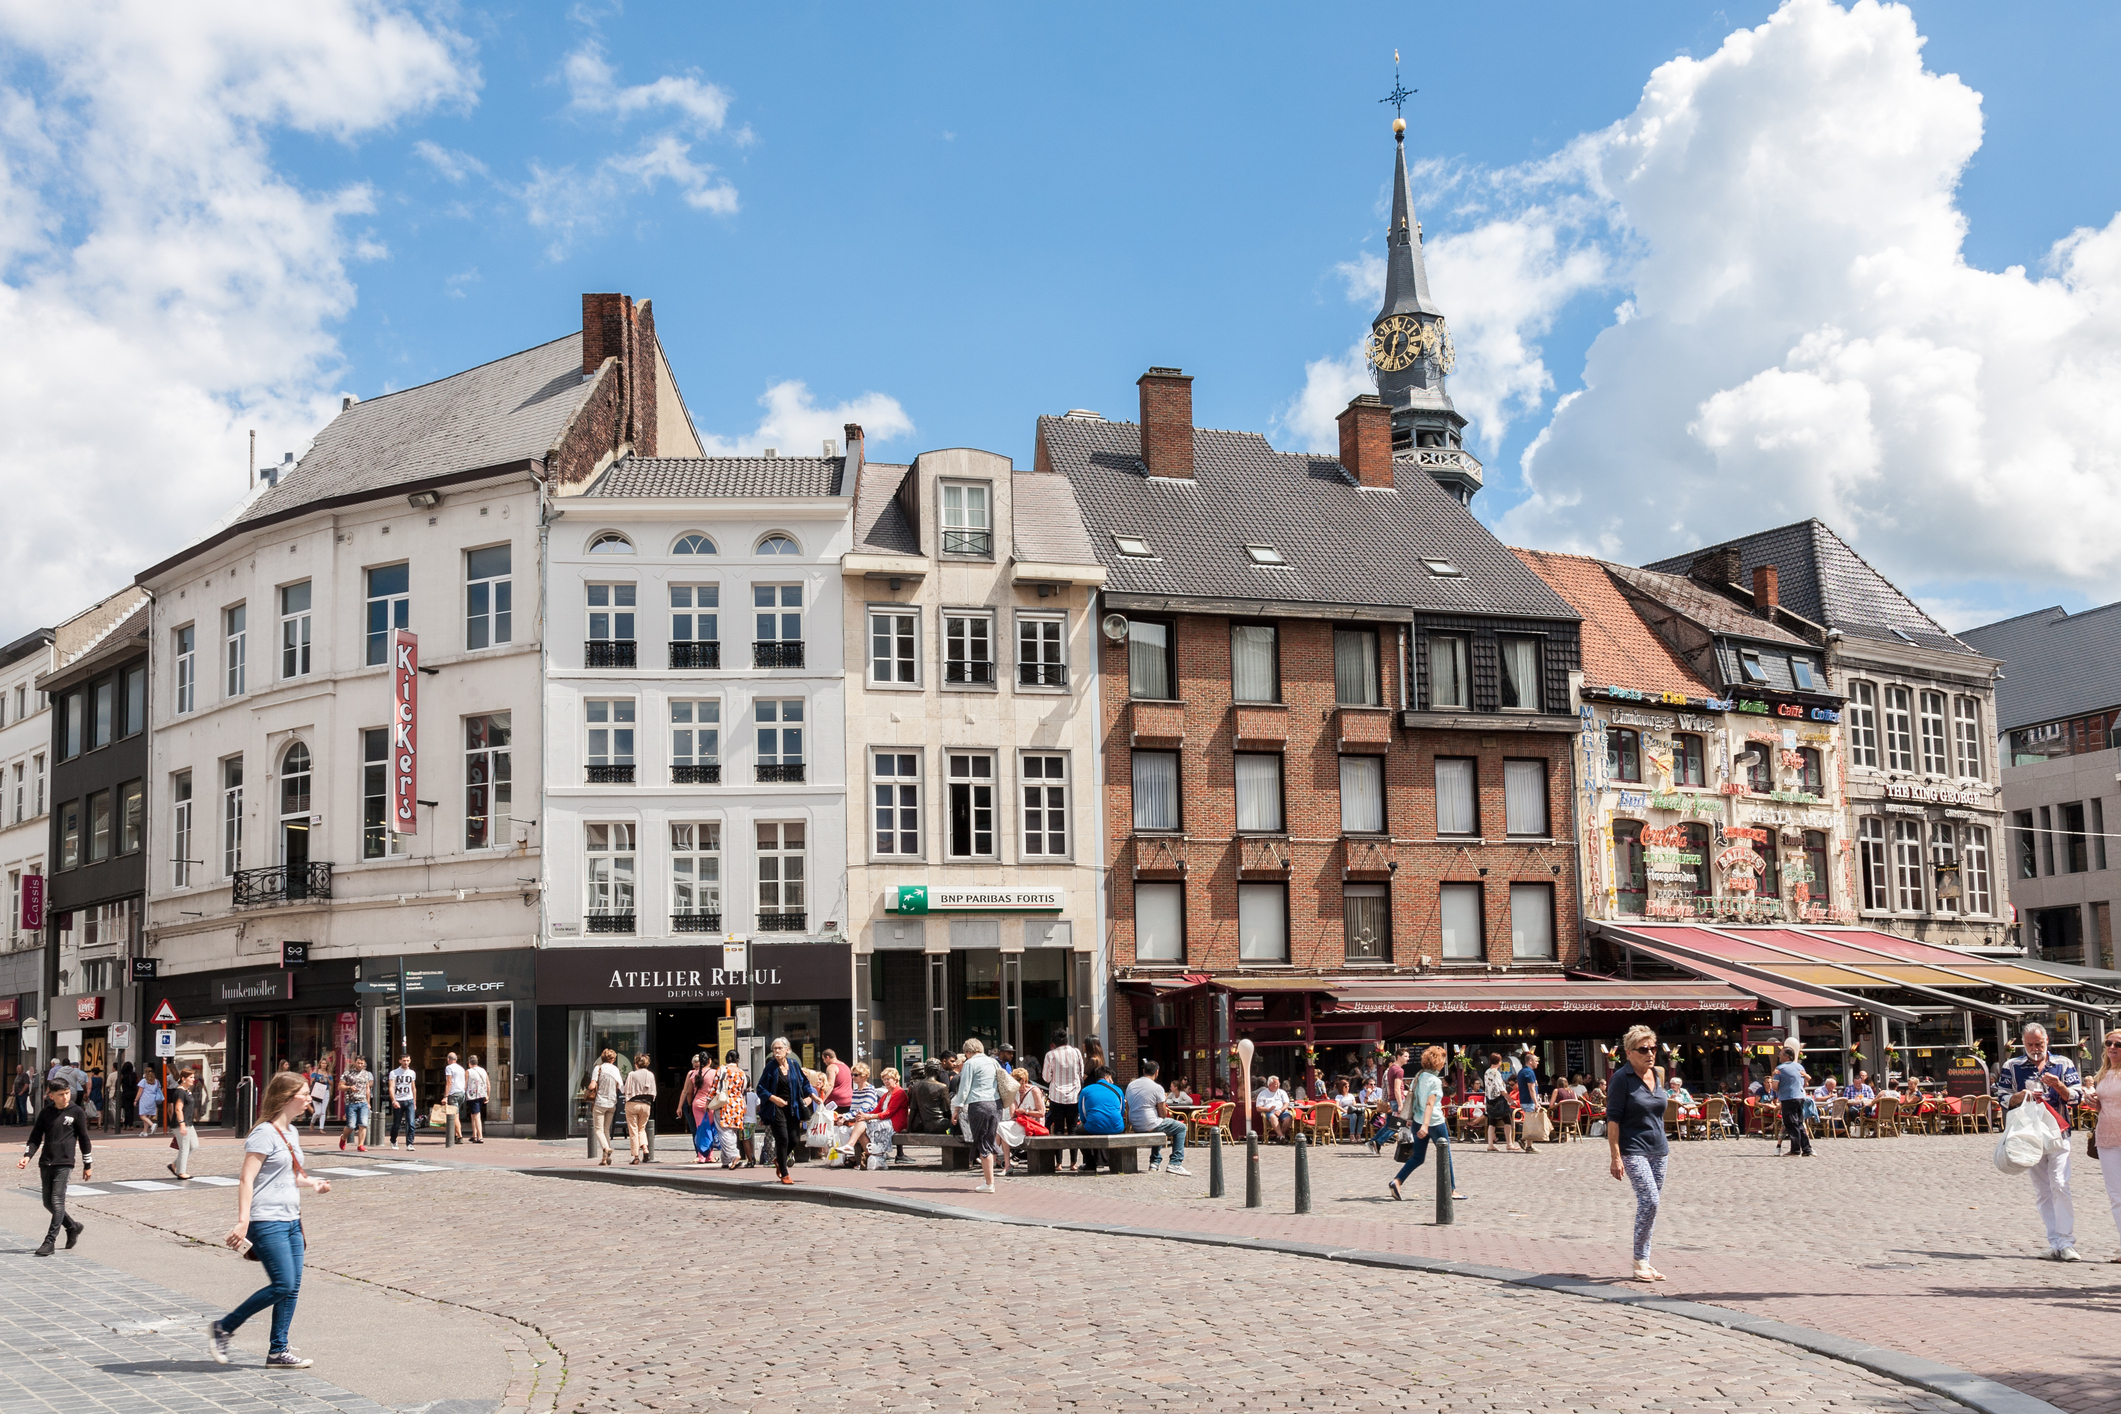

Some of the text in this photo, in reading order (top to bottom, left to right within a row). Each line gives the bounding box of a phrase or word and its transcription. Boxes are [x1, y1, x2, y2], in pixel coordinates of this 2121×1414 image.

[1610, 708, 1716, 733] Limburgse Witte
[1580, 705, 1596, 806] MARTINI
[1885, 784, 1981, 805] THE KING GEORGE
[1748, 809, 1794, 825] STELLA
[1588, 814, 1600, 911] CAMPARI
[1646, 866, 1697, 884] Hoegaarden
[27, 879, 40, 926] Cassis
[941, 894, 1055, 904] BNP PARIBAS FORTIS
[1645, 899, 1695, 917] Brasserie
[609, 969, 702, 988] ATELIER
[221, 979, 277, 1000] hunkemöller
[667, 990, 704, 998] DEPUIS
[1354, 1002, 1395, 1010] Brasserie
[1427, 1001, 1469, 1010] De Markt
[1499, 1001, 1532, 1009] Taverne
[1562, 1001, 1601, 1009] Brasserie
[1630, 1001, 1670, 1010] De Markt
[1699, 1001, 1730, 1009] Taverne
[396, 1076, 412, 1084] NO
[395, 1087, 410, 1095] NO
